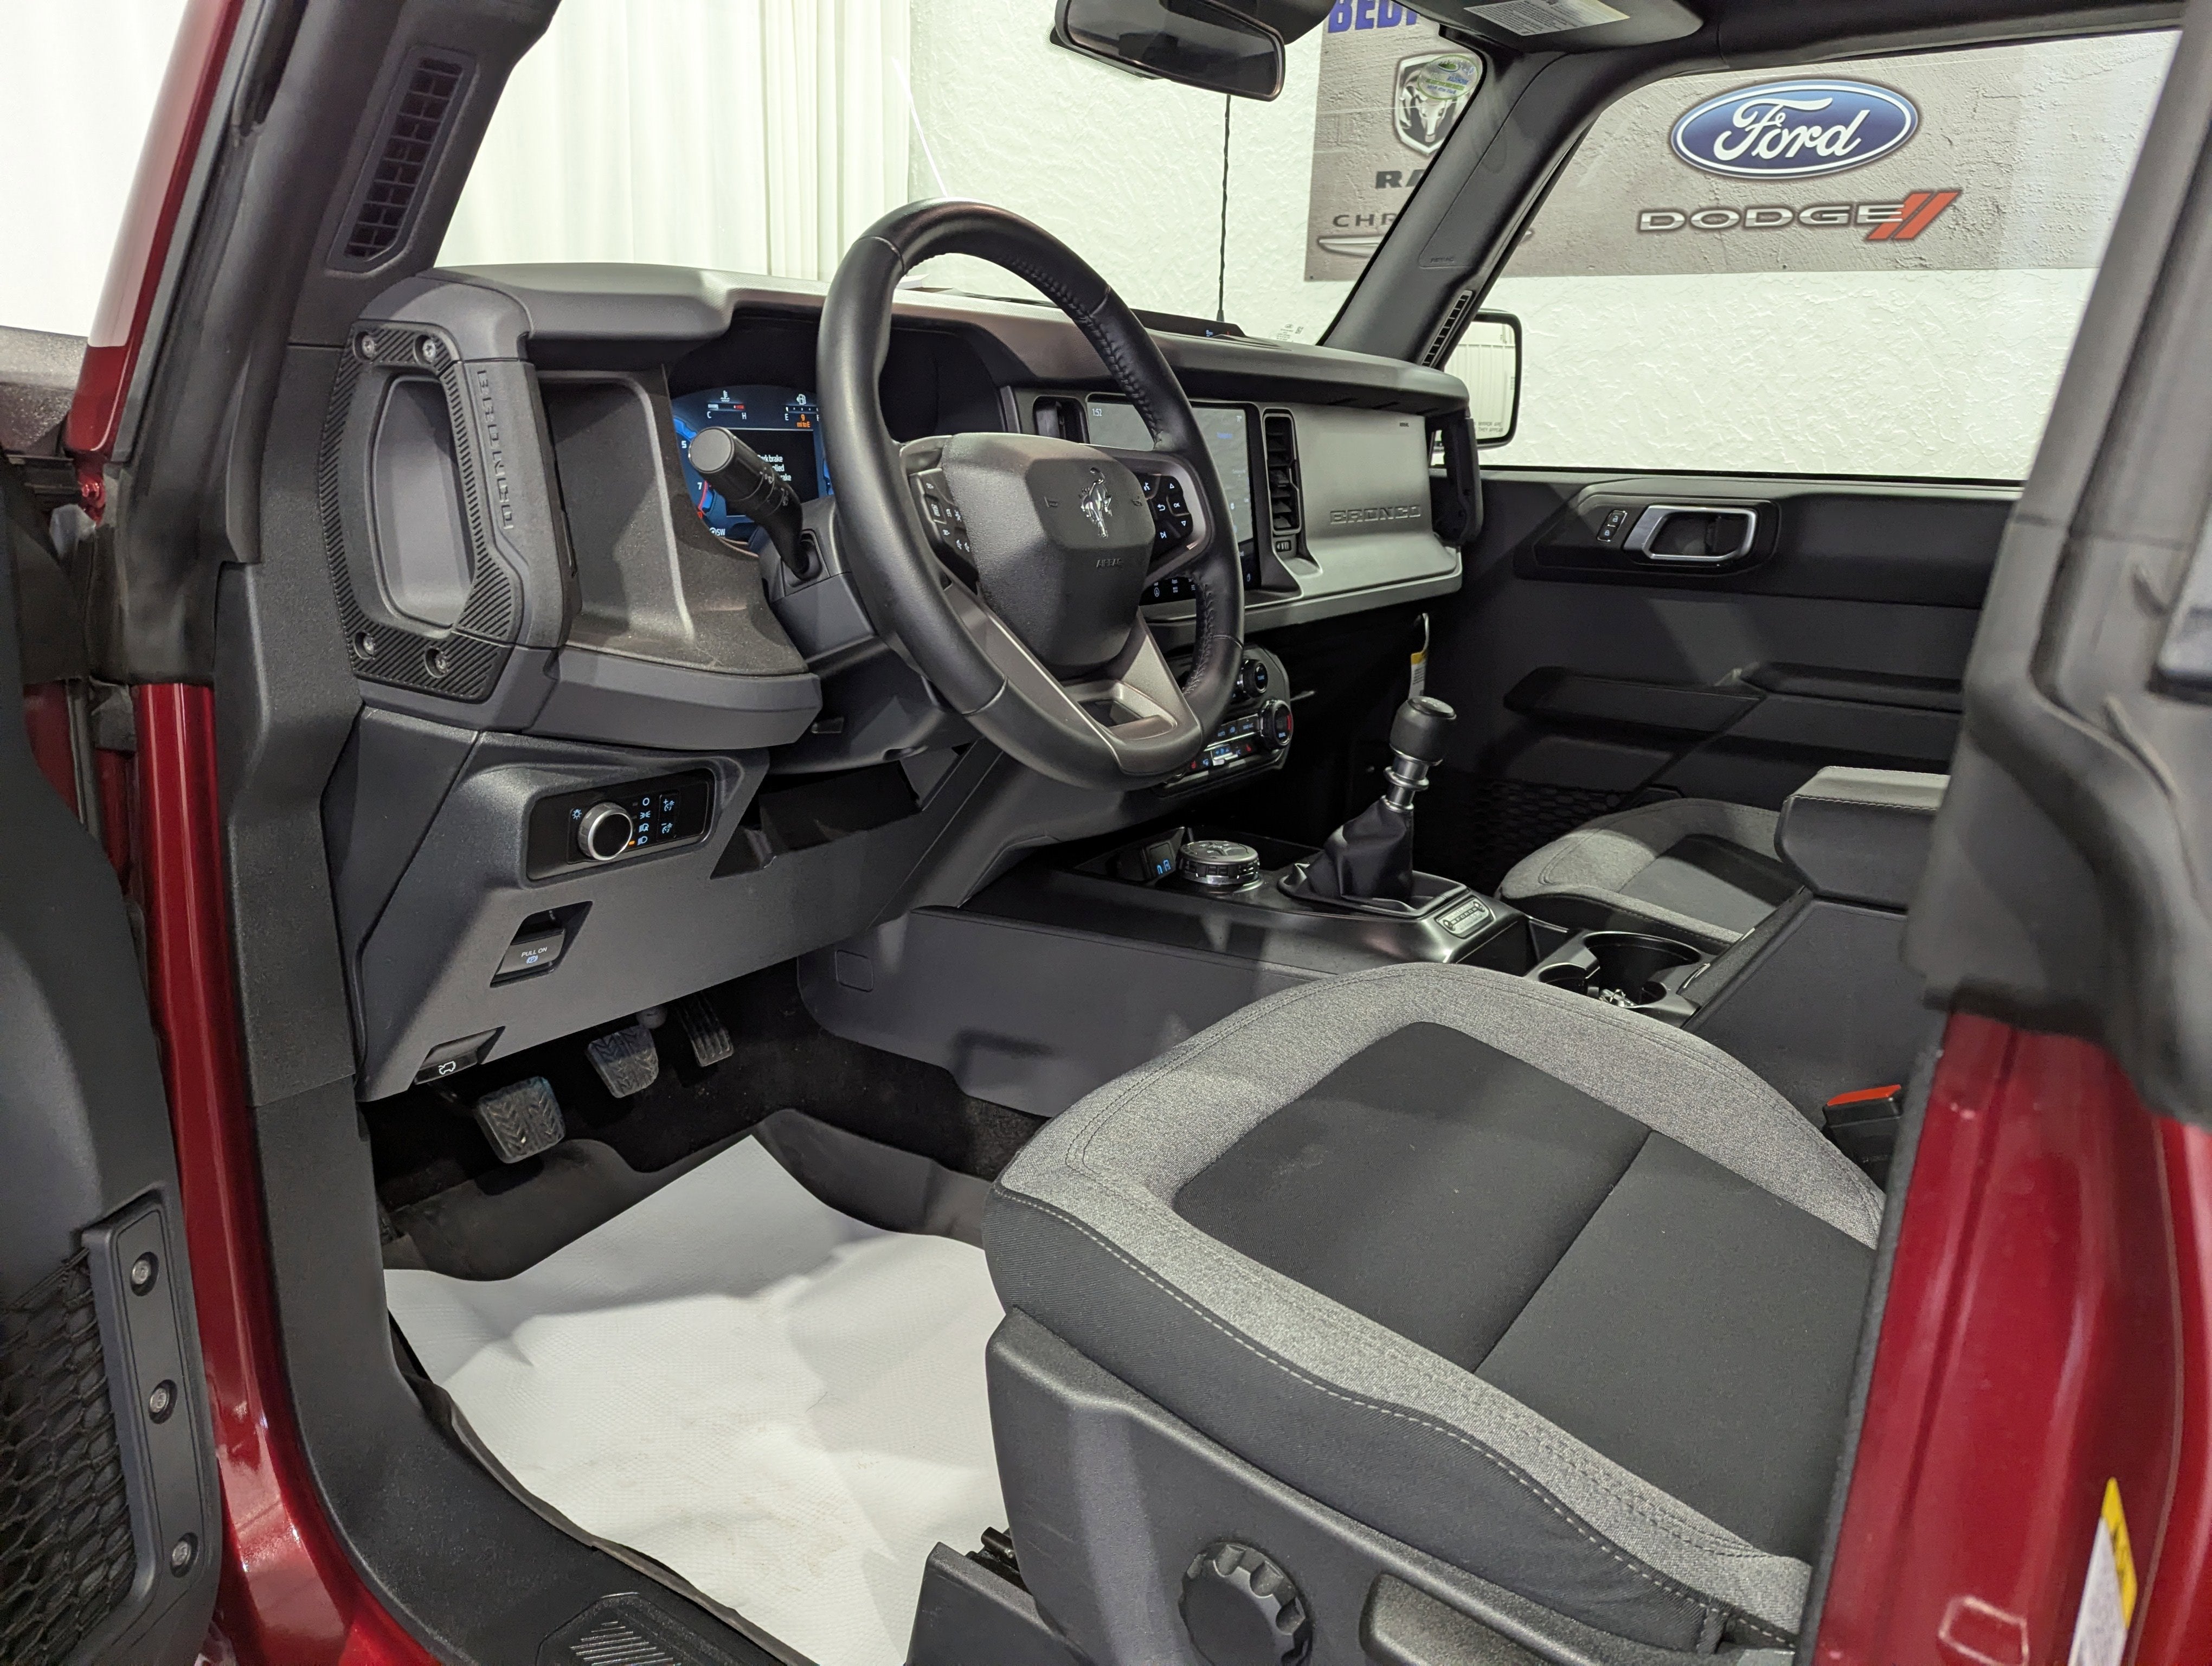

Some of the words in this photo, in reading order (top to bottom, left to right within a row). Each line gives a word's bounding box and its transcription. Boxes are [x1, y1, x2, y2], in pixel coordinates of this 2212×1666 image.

[1713, 97, 1870, 161] Ford
[1640, 204, 1905, 231] DODGE
[706, 411, 712, 419] C
[741, 412, 747, 420] H
[784, 413, 789, 421] E
[800, 413, 806, 421] 9
[1092, 408, 1103, 417] 1:52
[681, 440, 687, 449] 5
[477, 370, 514, 530] BRONCO
[768, 454, 783, 463] brake
[697, 482, 703, 490] 7
[1330, 505, 1421, 524] BRONCO
